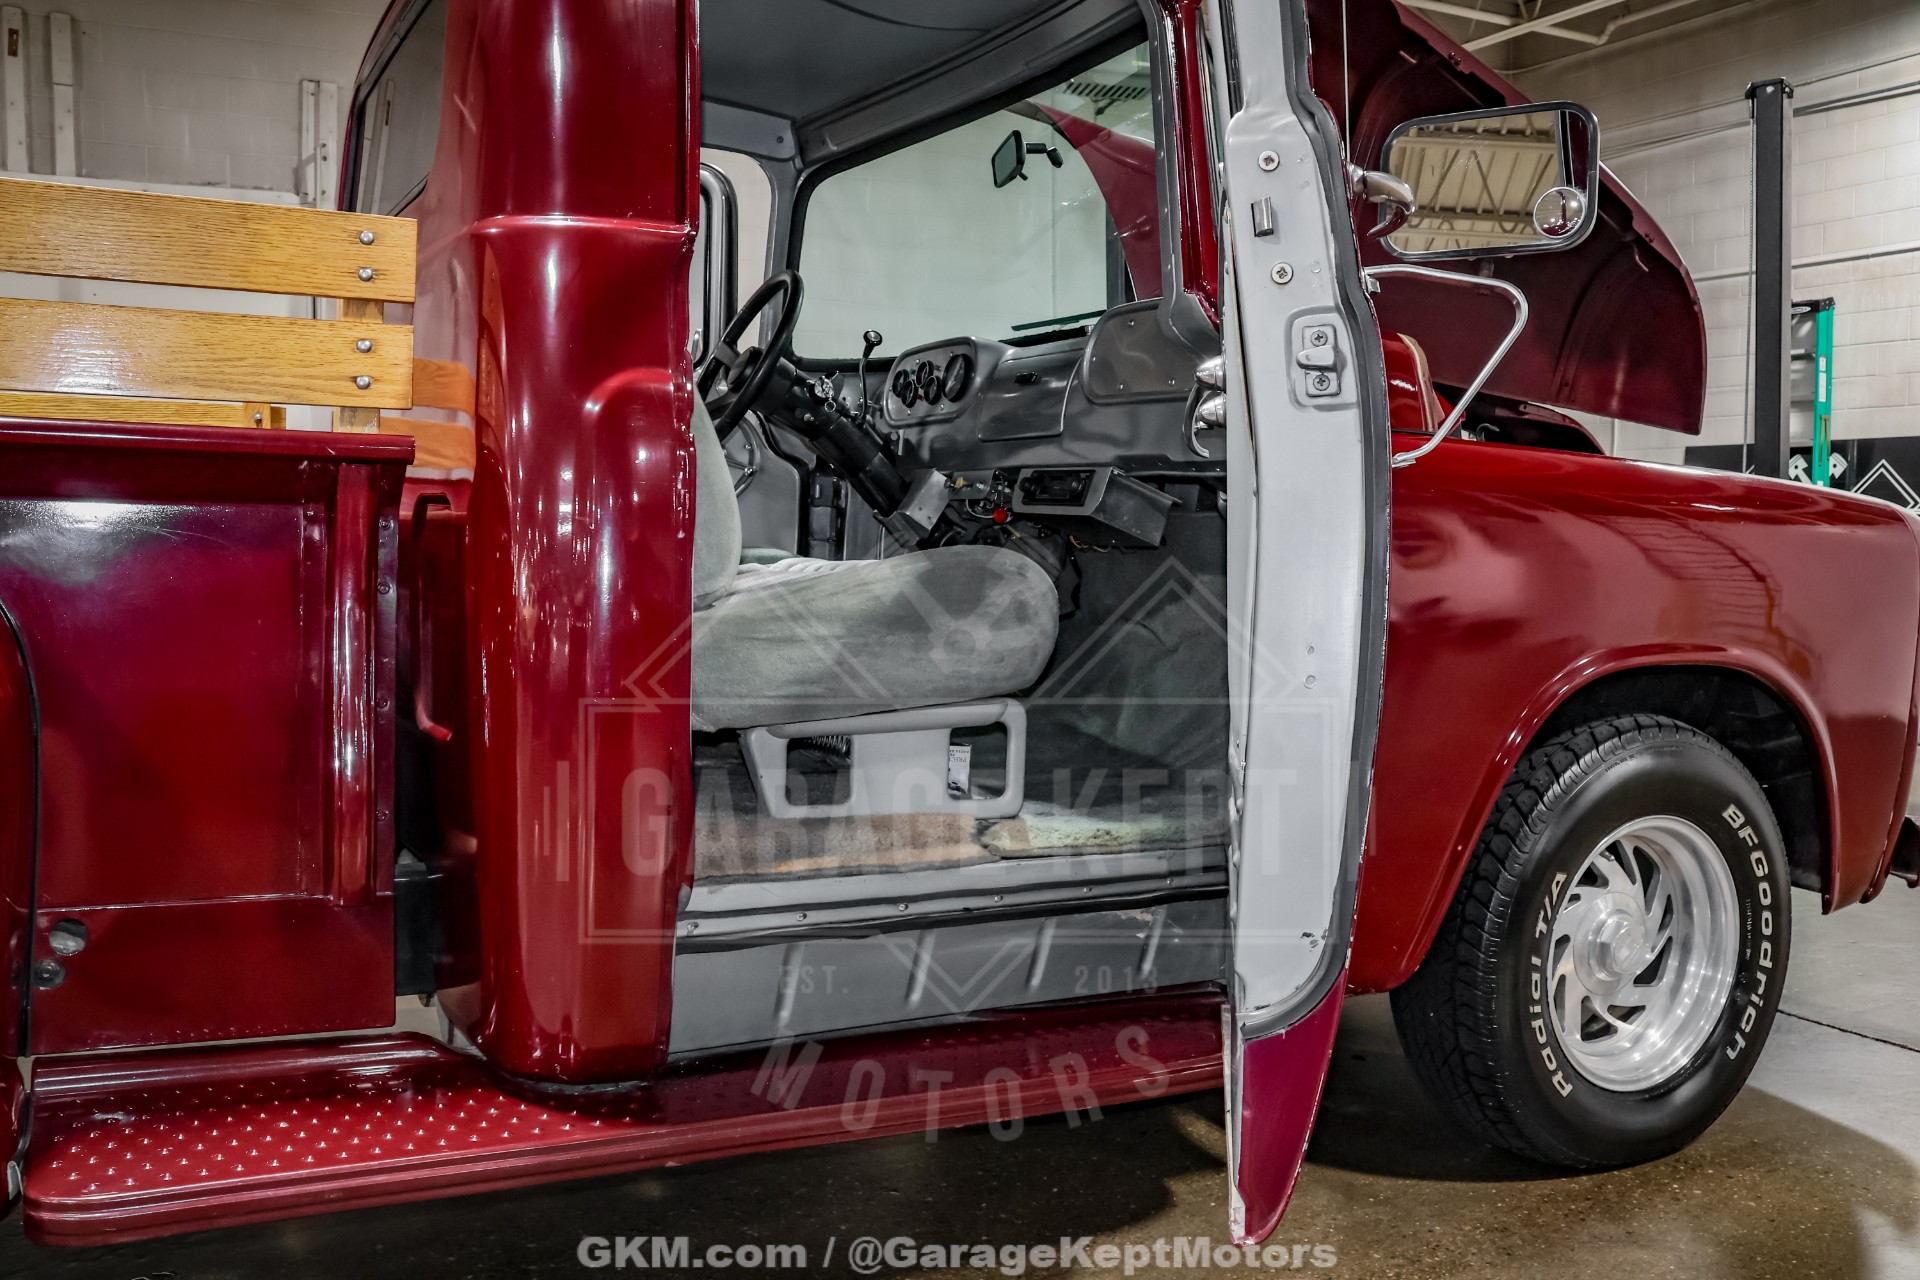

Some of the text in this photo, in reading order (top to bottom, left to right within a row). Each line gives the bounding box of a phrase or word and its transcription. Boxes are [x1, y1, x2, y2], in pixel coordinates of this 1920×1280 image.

[1528, 871, 1574, 1098] Radial T/A
[1721, 803, 1773, 1061] BFGoodrich
